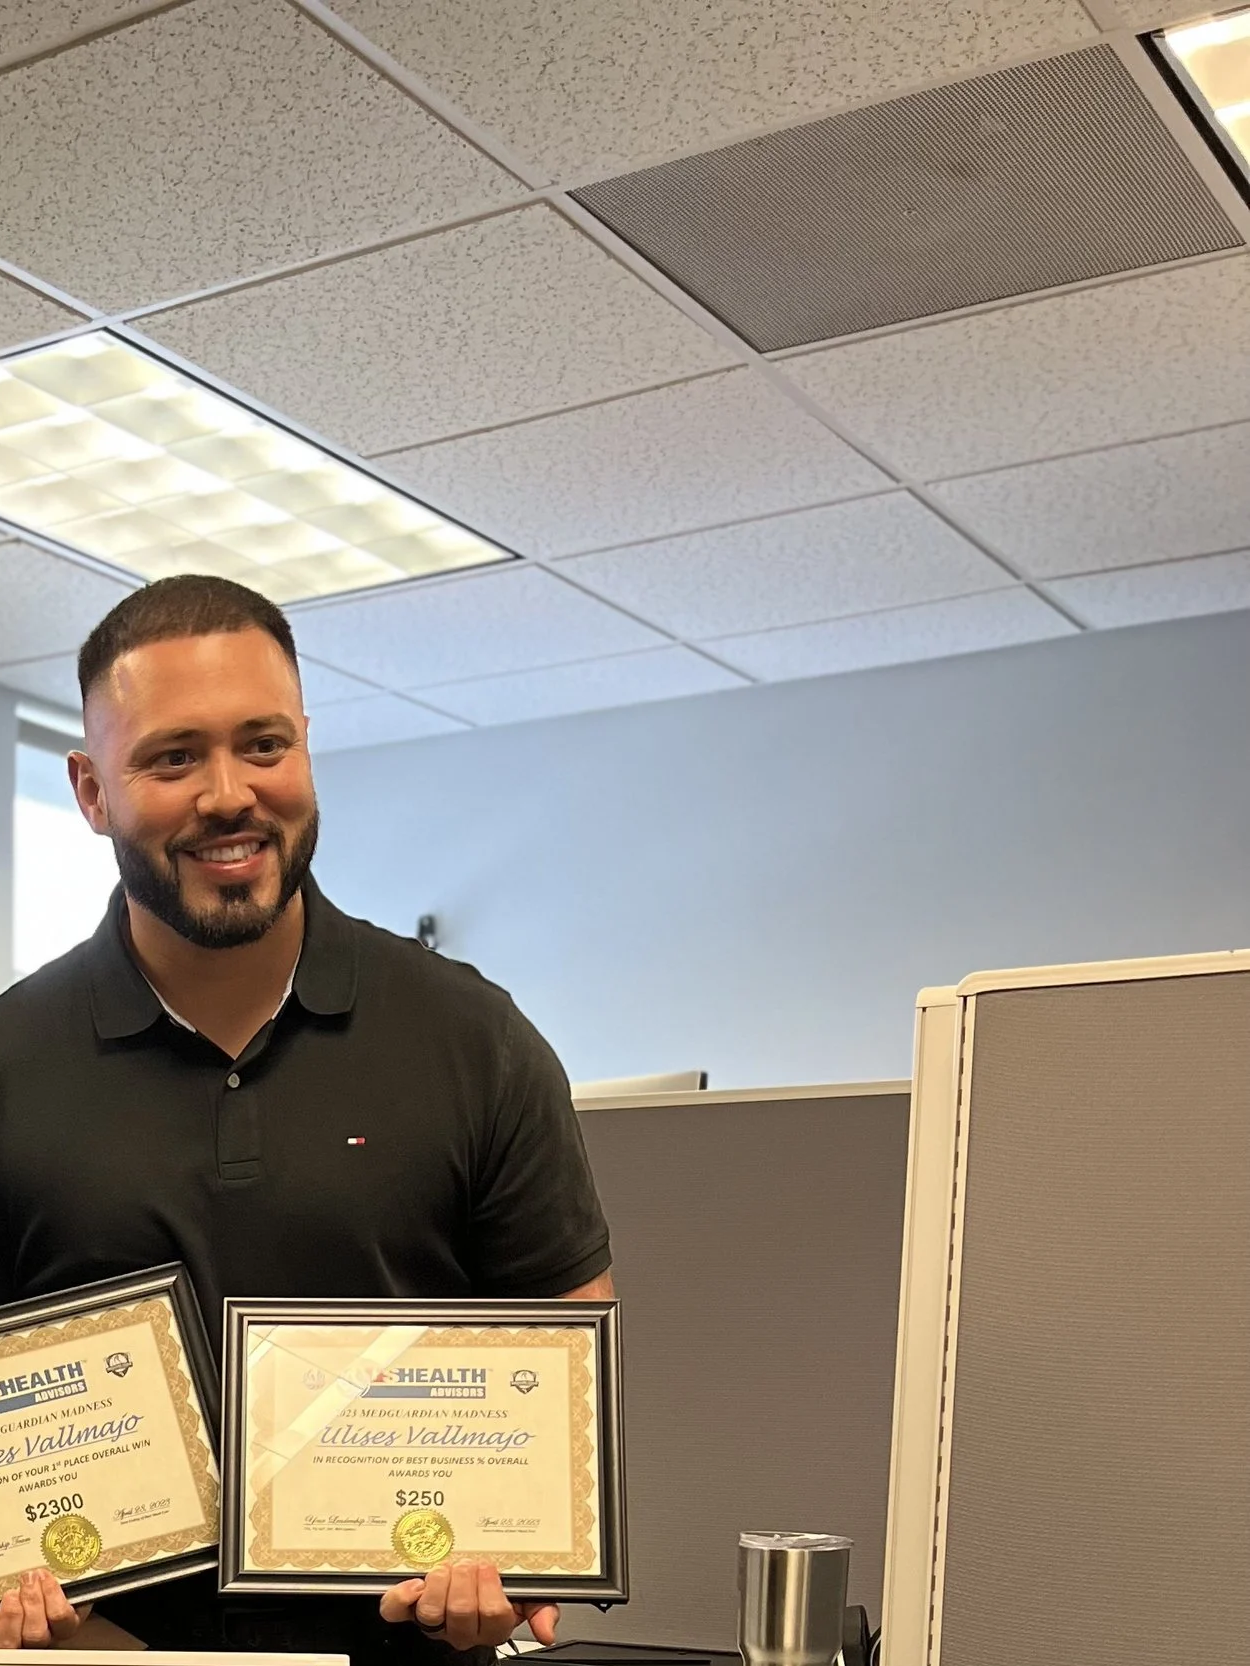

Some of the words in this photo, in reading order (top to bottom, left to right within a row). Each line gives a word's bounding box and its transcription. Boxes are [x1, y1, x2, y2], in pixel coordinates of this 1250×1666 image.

[34, 1381, 86, 1403] ADVISORS
[430, 1387, 484, 1398] ADVISORS
[60, 1398, 113, 1420] MADNESS
[361, 1409, 448, 1418] MEDGUARDIAN
[450, 1409, 508, 1418] MADNESS
[24, 1413, 144, 1457] Vallmajo
[320, 1424, 402, 1446] Ulises
[406, 1425, 536, 1453] Vallmajo
[11, 1472, 23, 1482] OF
[25, 1466, 50, 1478] YOUR
[51, 1461, 62, 1471] 1st
[63, 1456, 90, 1468] PLACE
[92, 1446, 130, 1461] OVERALL
[132, 1439, 151, 1449] WIN
[325, 1456, 389, 1464] RECOGNITION
[392, 1456, 403, 1464] OF
[406, 1456, 428, 1464] BEST
[430, 1456, 475, 1465] BUSINESS
[476, 1456, 486, 1465] %
[487, 1457, 529, 1465] OVERALL
[18, 1478, 57, 1493] AWARDS
[58, 1472, 78, 1482] YOU
[388, 1470, 430, 1478] AWARDS
[432, 1470, 453, 1478] YOU
[25, 1493, 84, 1523] $2300
[395, 1489, 445, 1507] $250
